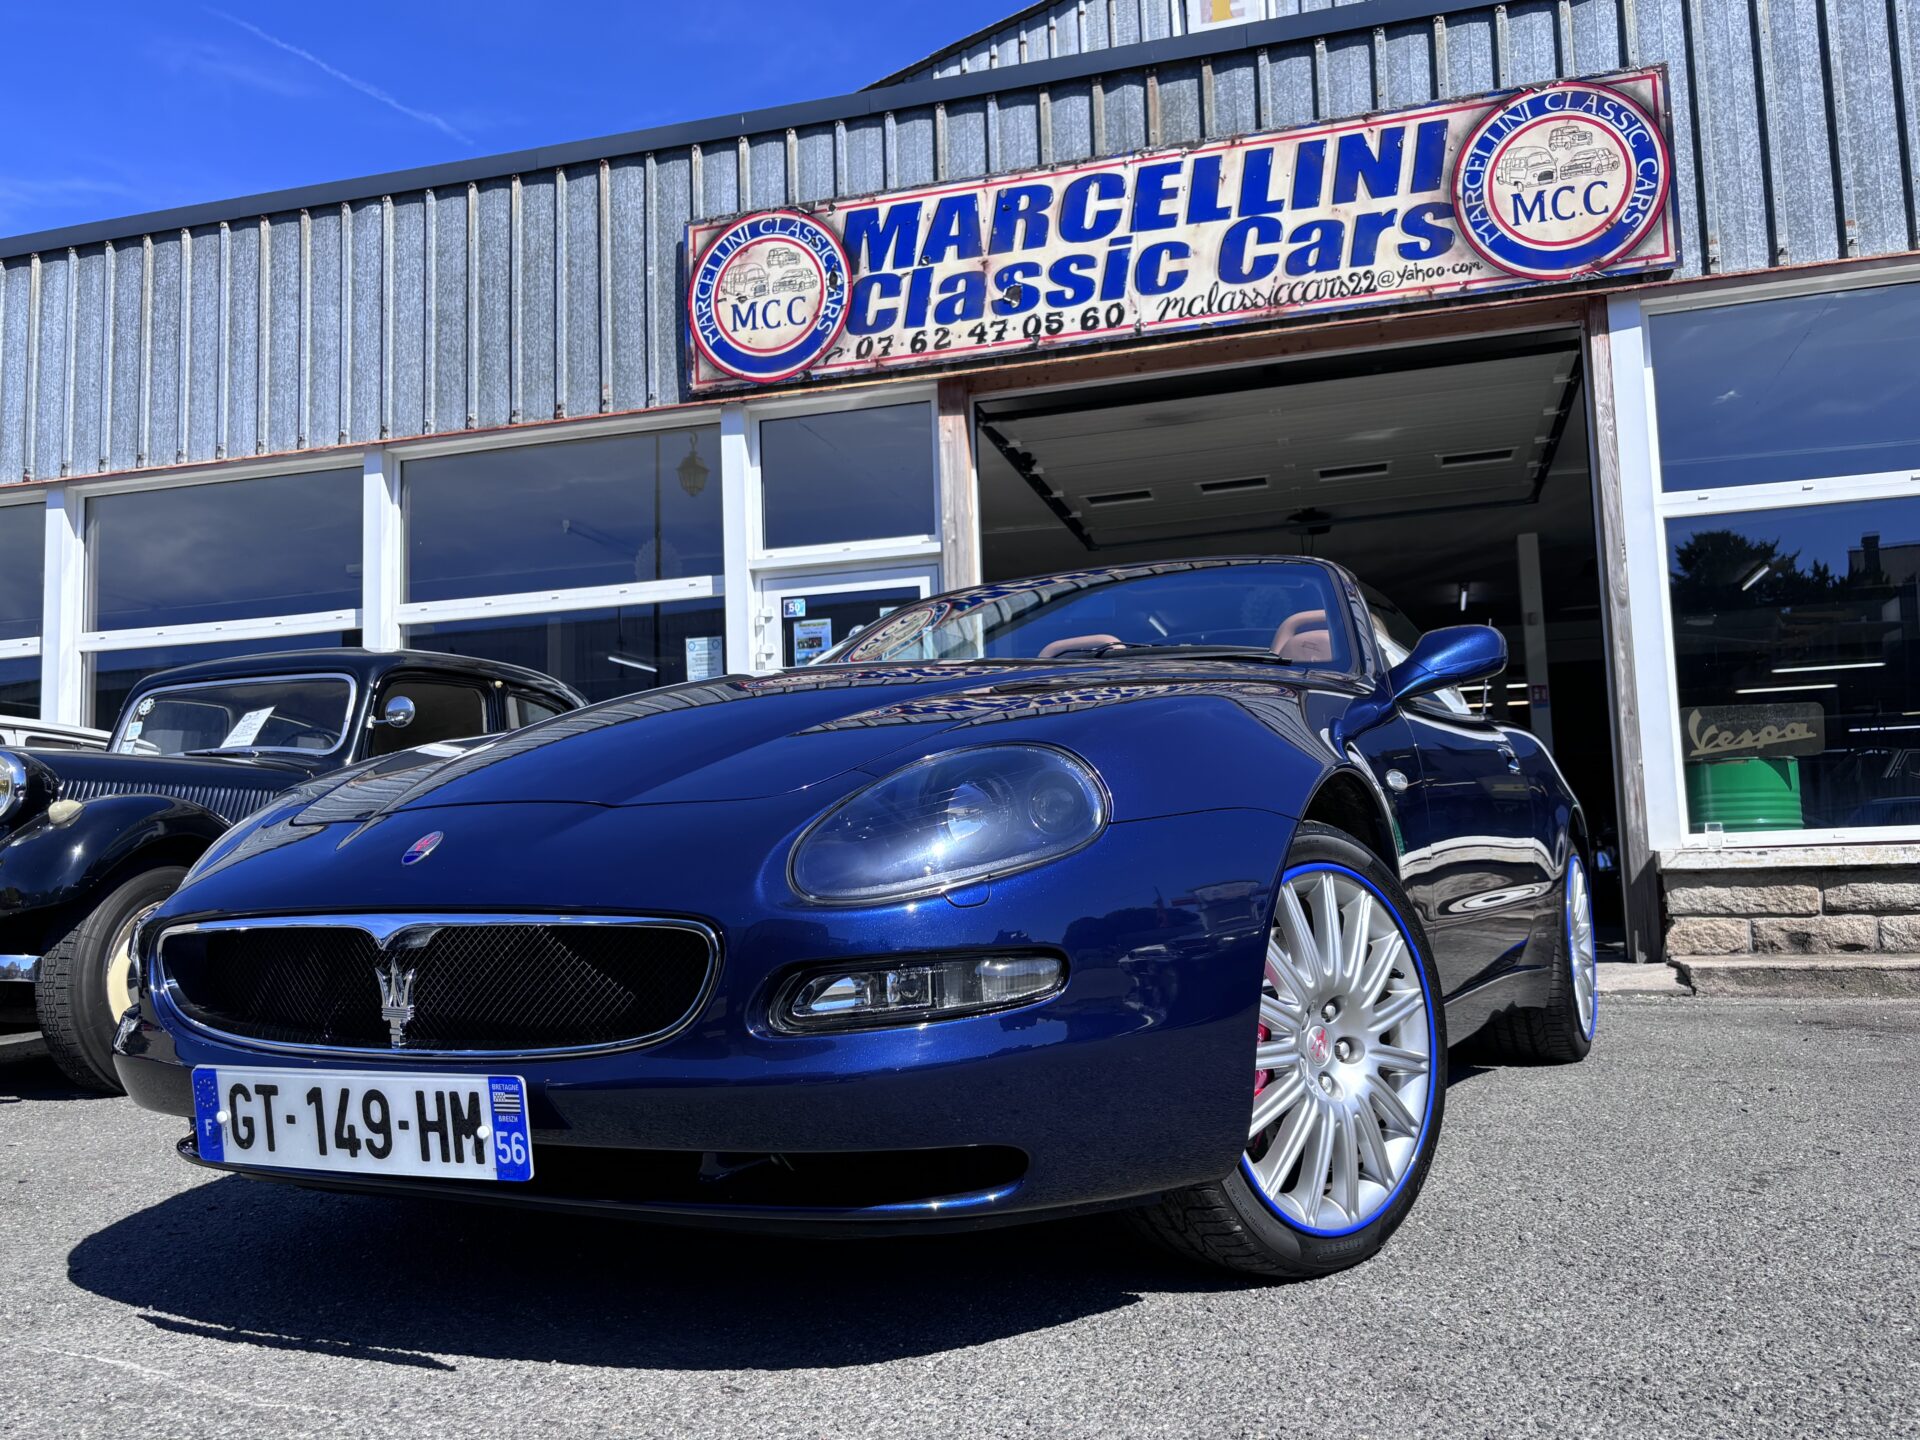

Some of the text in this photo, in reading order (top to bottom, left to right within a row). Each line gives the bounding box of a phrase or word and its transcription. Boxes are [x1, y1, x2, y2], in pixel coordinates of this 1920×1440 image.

[842, 118, 1449, 275] MARCELLINI
[1464, 91, 1659, 246] MARCELLINI CLASSIC CARS
[695, 225, 751, 346] MARCELLINI
[759, 218, 839, 268] CLASSIC
[846, 202, 1456, 336] Classic Cars
[1687, 708, 1817, 757] Vespa
[204, 1118, 213, 1137] F
[495, 1130, 526, 1165] 56
